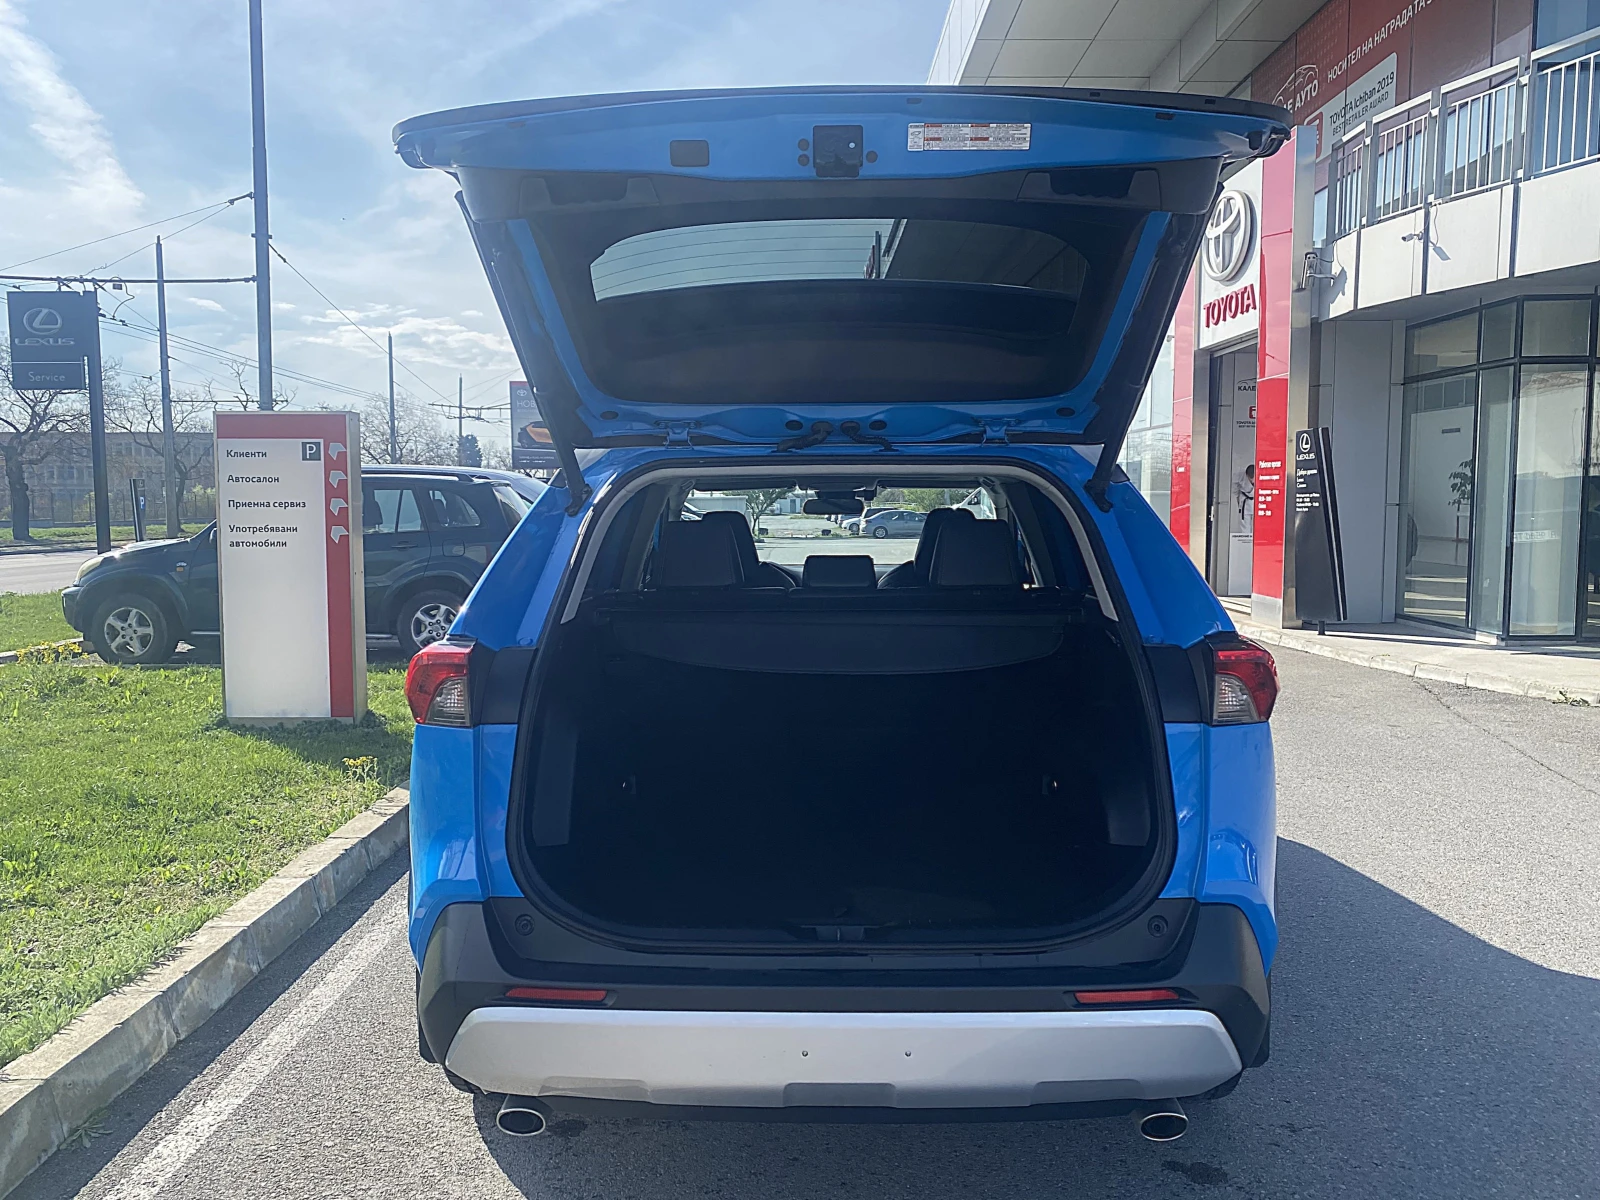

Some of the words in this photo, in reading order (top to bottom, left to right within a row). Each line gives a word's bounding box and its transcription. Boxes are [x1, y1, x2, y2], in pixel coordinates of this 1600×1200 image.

[1328, 47, 1361, 83] НОСИТЕЛ
[1362, 37, 1373, 56] НА
[1295, 79, 1318, 111] АУТО
[1330, 100, 1353, 126] TOYOTA
[1353, 87, 1376, 108] Ichiban
[1376, 71, 1395, 93] 2019
[1332, 122, 1344, 136] BEST
[1345, 105, 1369, 127] RETAILER
[1369, 91, 1389, 111] AWARD
[1203, 283, 1257, 328] TOYOTA
[15, 338, 75, 346] LEXUS
[28, 371, 66, 382] Service
[226, 449, 267, 458] Клиенти
[306, 443, 317, 459] P
[1296, 453, 1316, 461] LEXUS
[227, 474, 280, 483] Автосалон
[228, 499, 271, 510] Приемна
[272, 501, 306, 510] сервиз
[228, 524, 298, 535] Употребявани
[229, 539, 287, 548] автомобили
